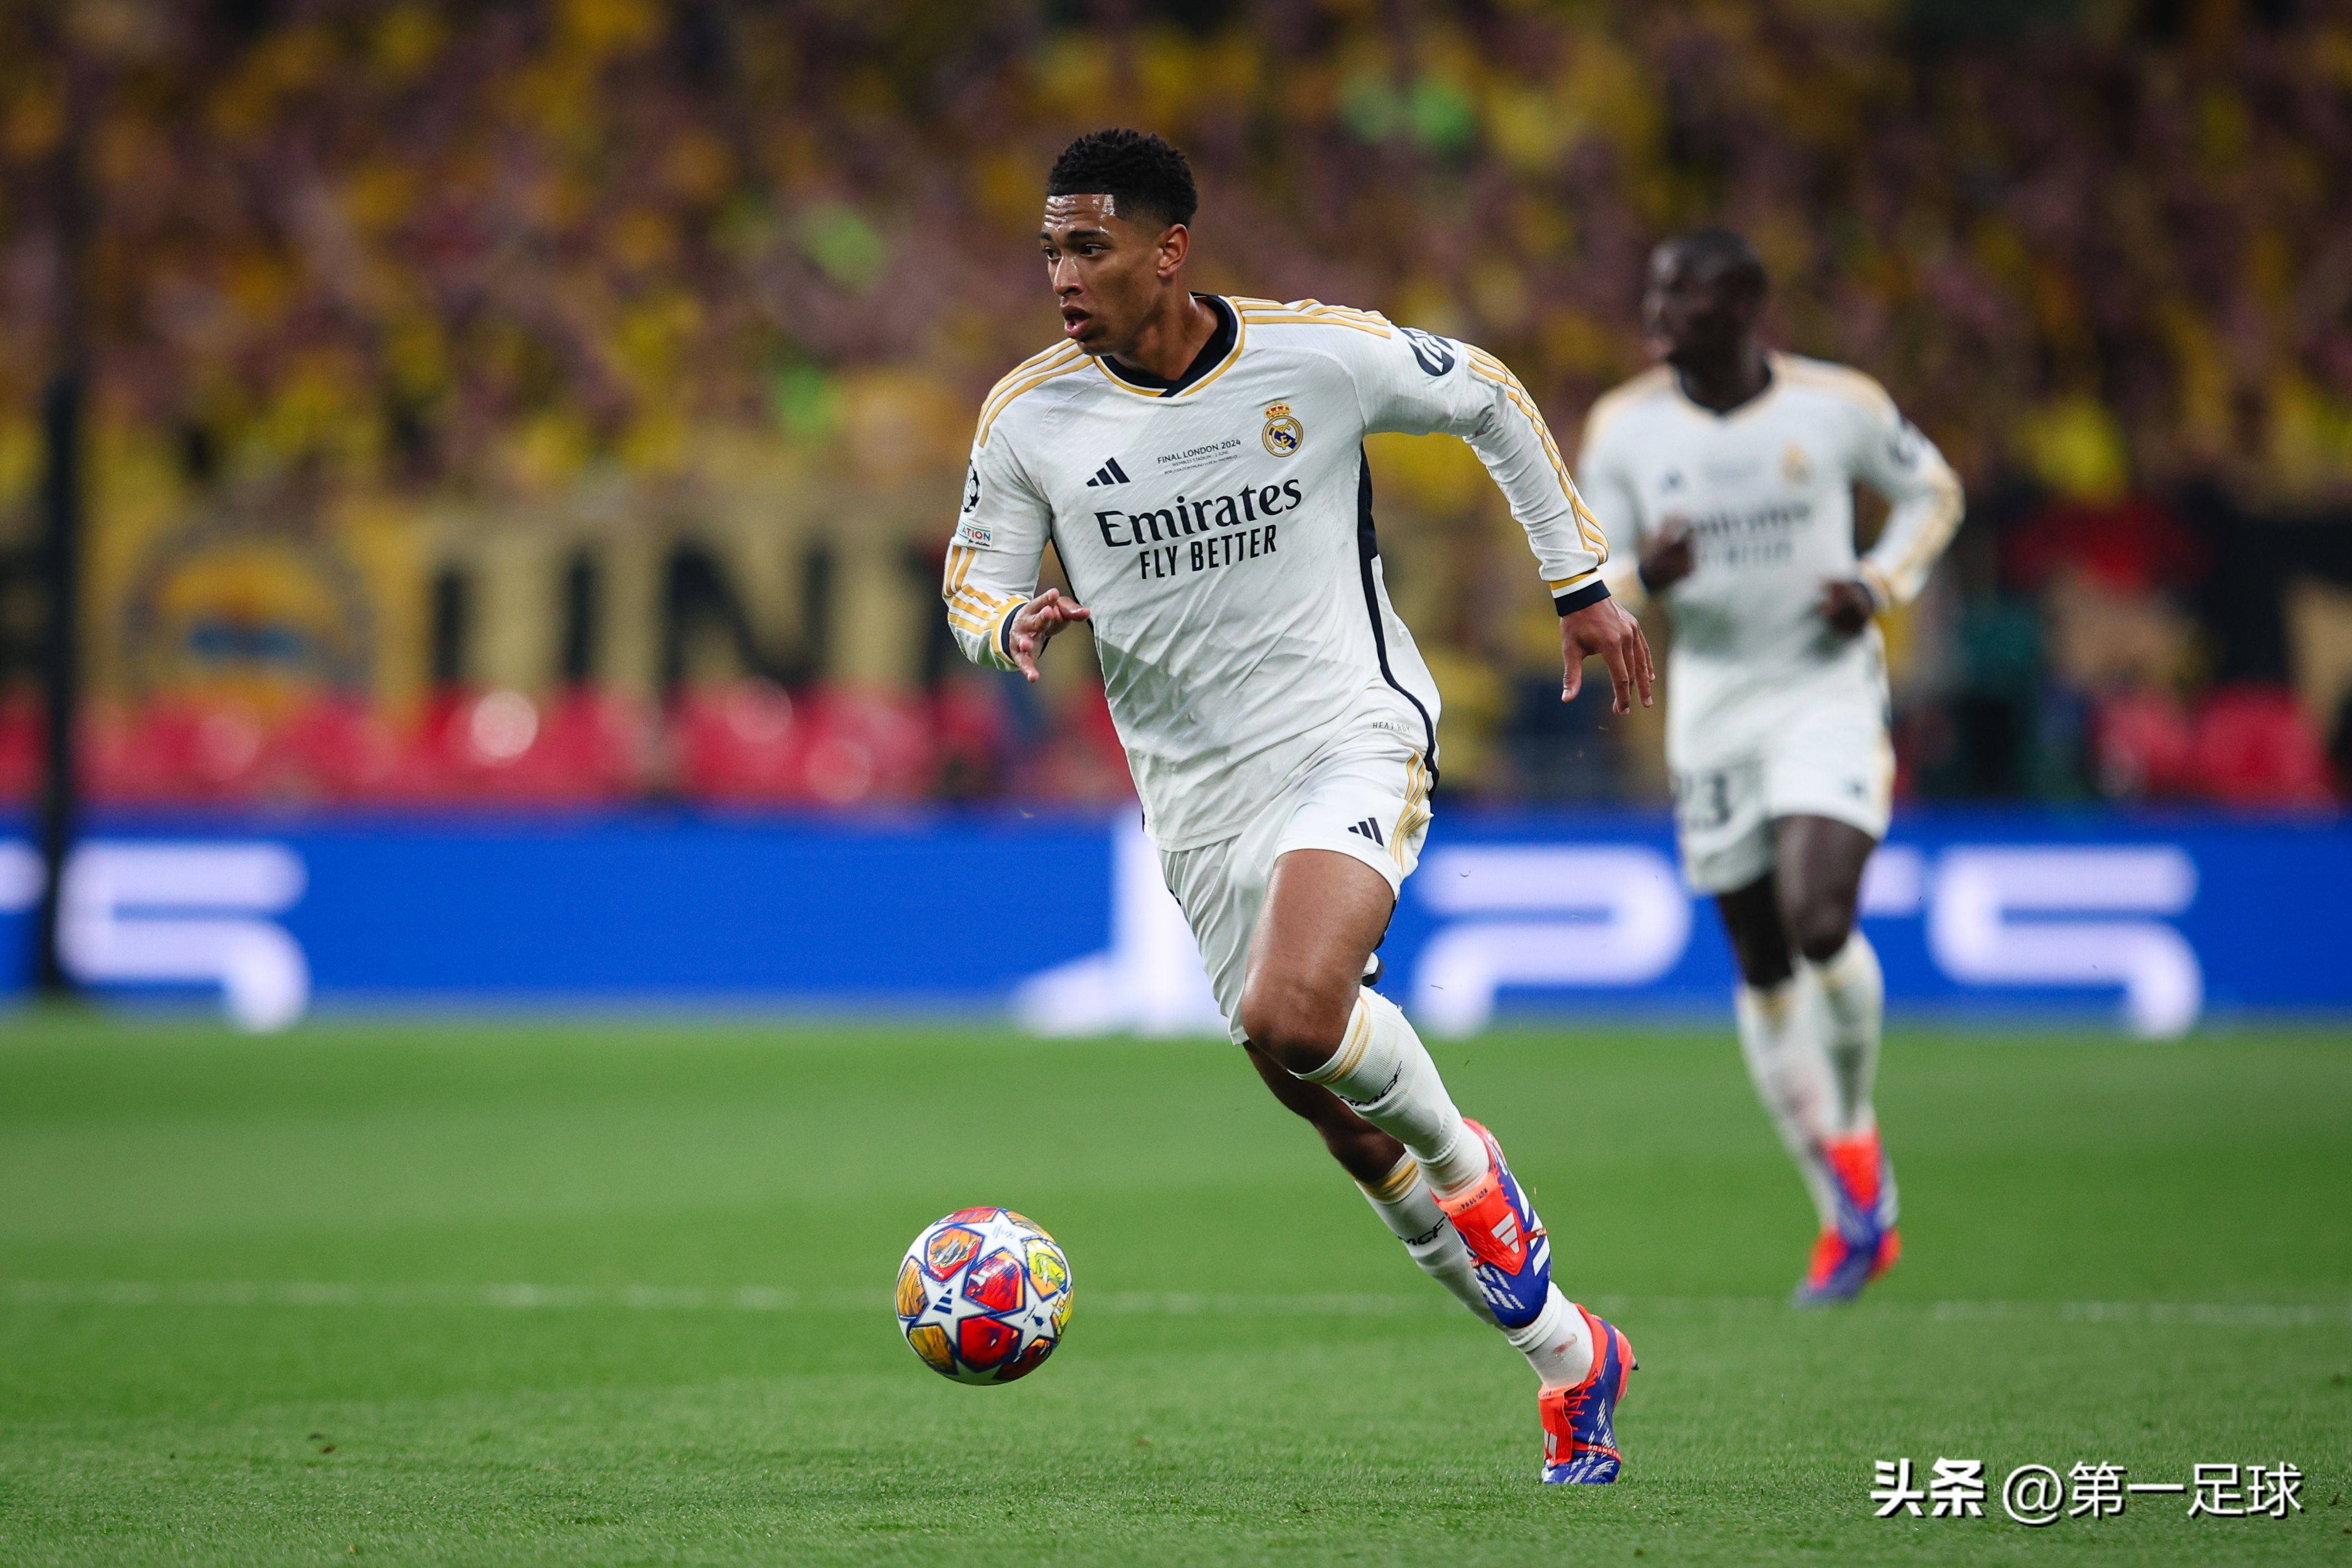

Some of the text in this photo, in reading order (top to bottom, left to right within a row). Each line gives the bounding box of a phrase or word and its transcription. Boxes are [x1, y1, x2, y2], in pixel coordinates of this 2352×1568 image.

[1157, 439, 1241, 464] FINAL LONDON 2024
[1093, 479, 1301, 547] Emirates
[1140, 524, 1276, 579] FLY BETTER
